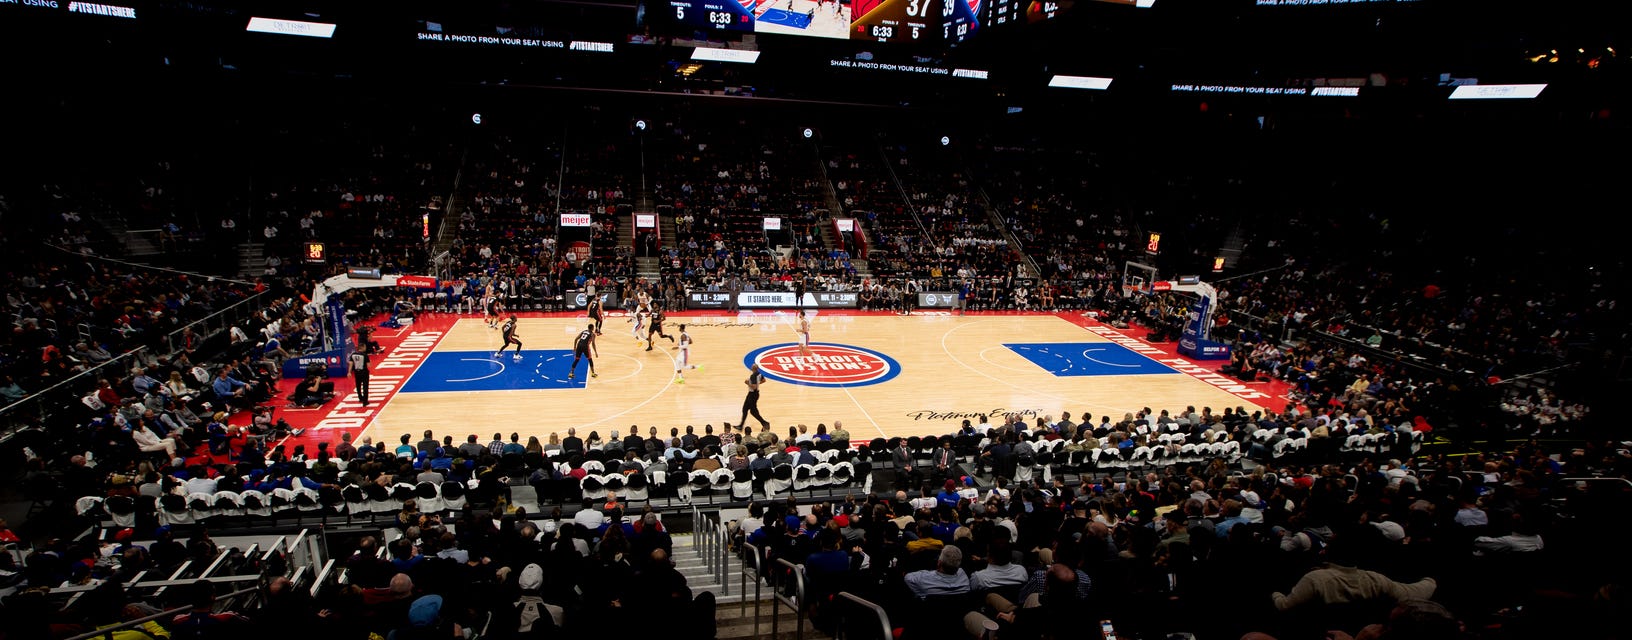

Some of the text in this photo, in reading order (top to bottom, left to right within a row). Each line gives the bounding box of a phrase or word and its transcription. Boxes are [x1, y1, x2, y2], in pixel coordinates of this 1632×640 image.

[676, 6, 685, 20] 5
[906, 0, 931, 17] 37
[943, 0, 955, 17] 39
[709, 11, 731, 24] 6:33
[872, 25, 893, 37] 6:33
[912, 27, 919, 39] 5
[417, 33, 443, 41] SHARE
[451, 35, 477, 43] PHOTO
[478, 36, 500, 44] FROM
[500, 37, 521, 46] YOUR
[522, 39, 540, 47] SEAT
[542, 40, 564, 48] USING
[830, 59, 851, 67] SHARE
[1171, 84, 1193, 92] SHARE
[1200, 85, 1224, 93] PHOTO
[1245, 86, 1265, 94] YOUR
[1283, 87, 1306, 95] USING
[562, 214, 589, 225] meijer
[1147, 239, 1158, 251] 20
[747, 295, 752, 303] IT
[753, 295, 771, 303] STARTS
[375, 331, 443, 370] PISTONS
[777, 362, 872, 372] PISTONS
[1085, 325, 1272, 399] DETROIT PISTONS
[906, 410, 986, 421] Platinum
